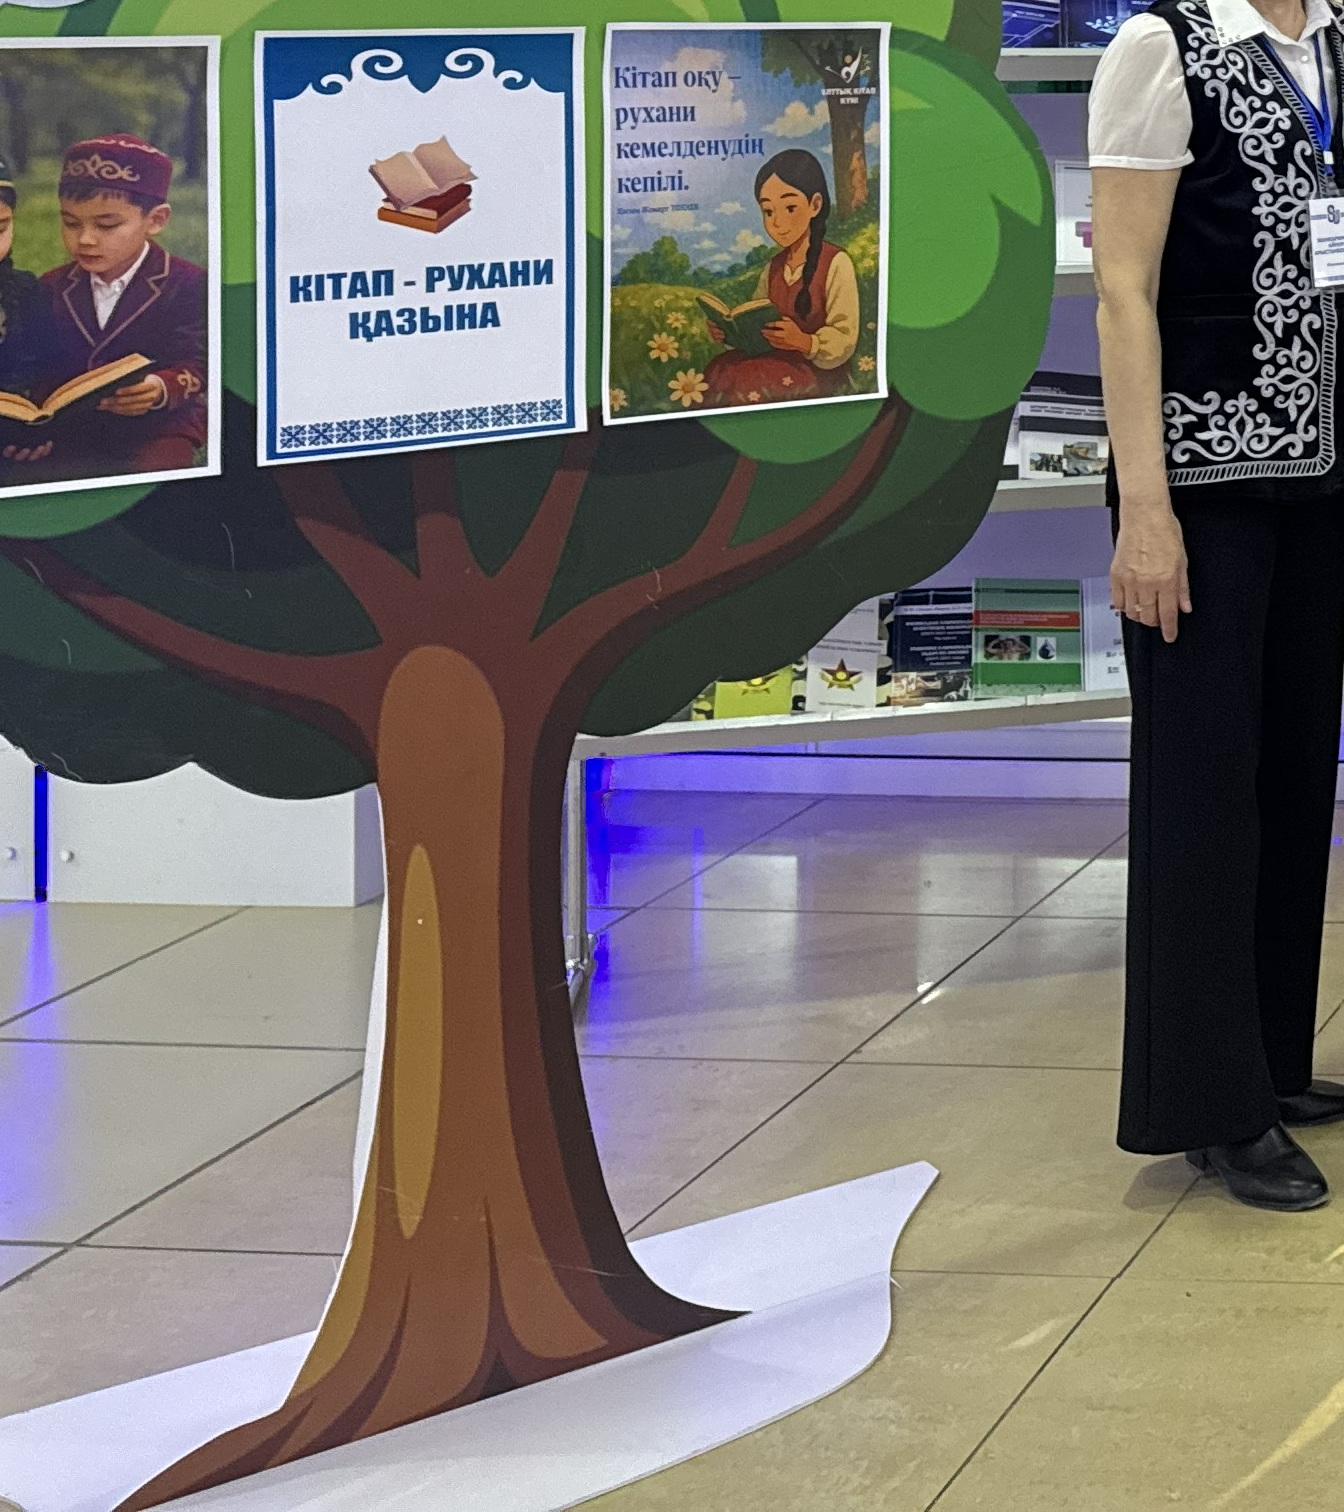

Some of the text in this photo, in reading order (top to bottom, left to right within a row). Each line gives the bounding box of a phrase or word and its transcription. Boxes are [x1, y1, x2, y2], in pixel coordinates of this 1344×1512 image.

[614, 66, 677, 88] Кітап
[683, 70, 722, 93] оқу
[615, 106, 696, 130] рухани
[616, 133, 764, 161] кемелденудің
[617, 170, 689, 193] кепілі.
[290, 269, 394, 303] КІТАП
[426, 259, 553, 293] РУХАНИ
[350, 301, 501, 342] ҚАЗЫНА
